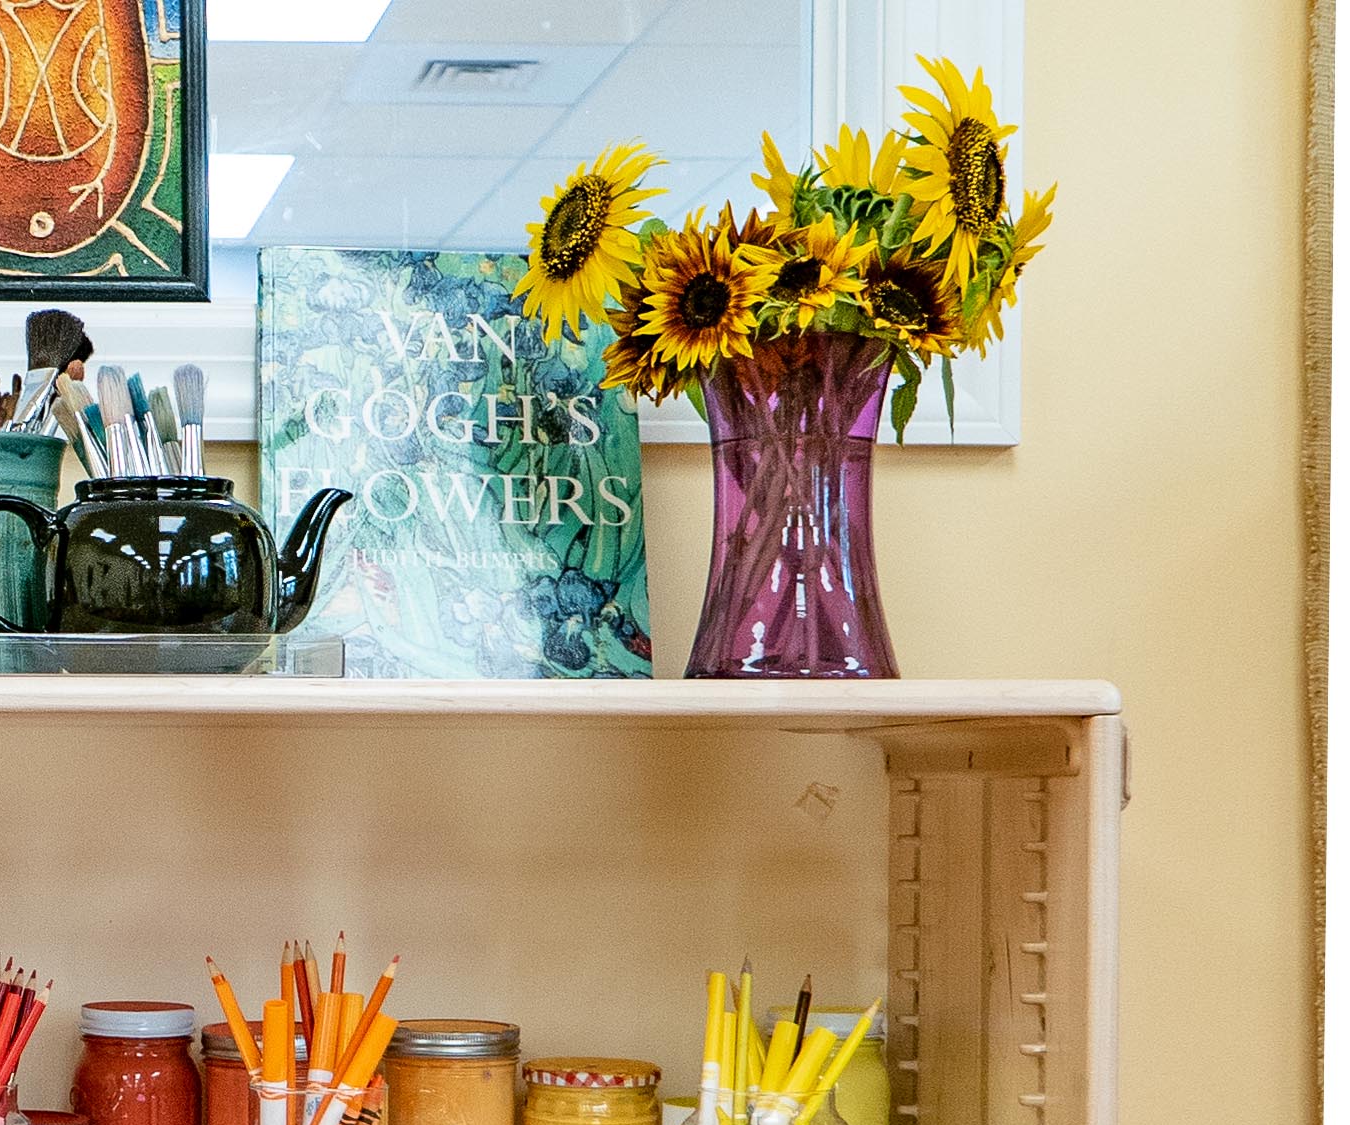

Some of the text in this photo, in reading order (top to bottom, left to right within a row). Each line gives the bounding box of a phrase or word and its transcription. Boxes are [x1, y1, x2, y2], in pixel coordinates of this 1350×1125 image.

[378, 311, 520, 365] VAN
[305, 387, 600, 446] GOGH'S
[353, 548, 559, 570] JUDITH BUMPUS
